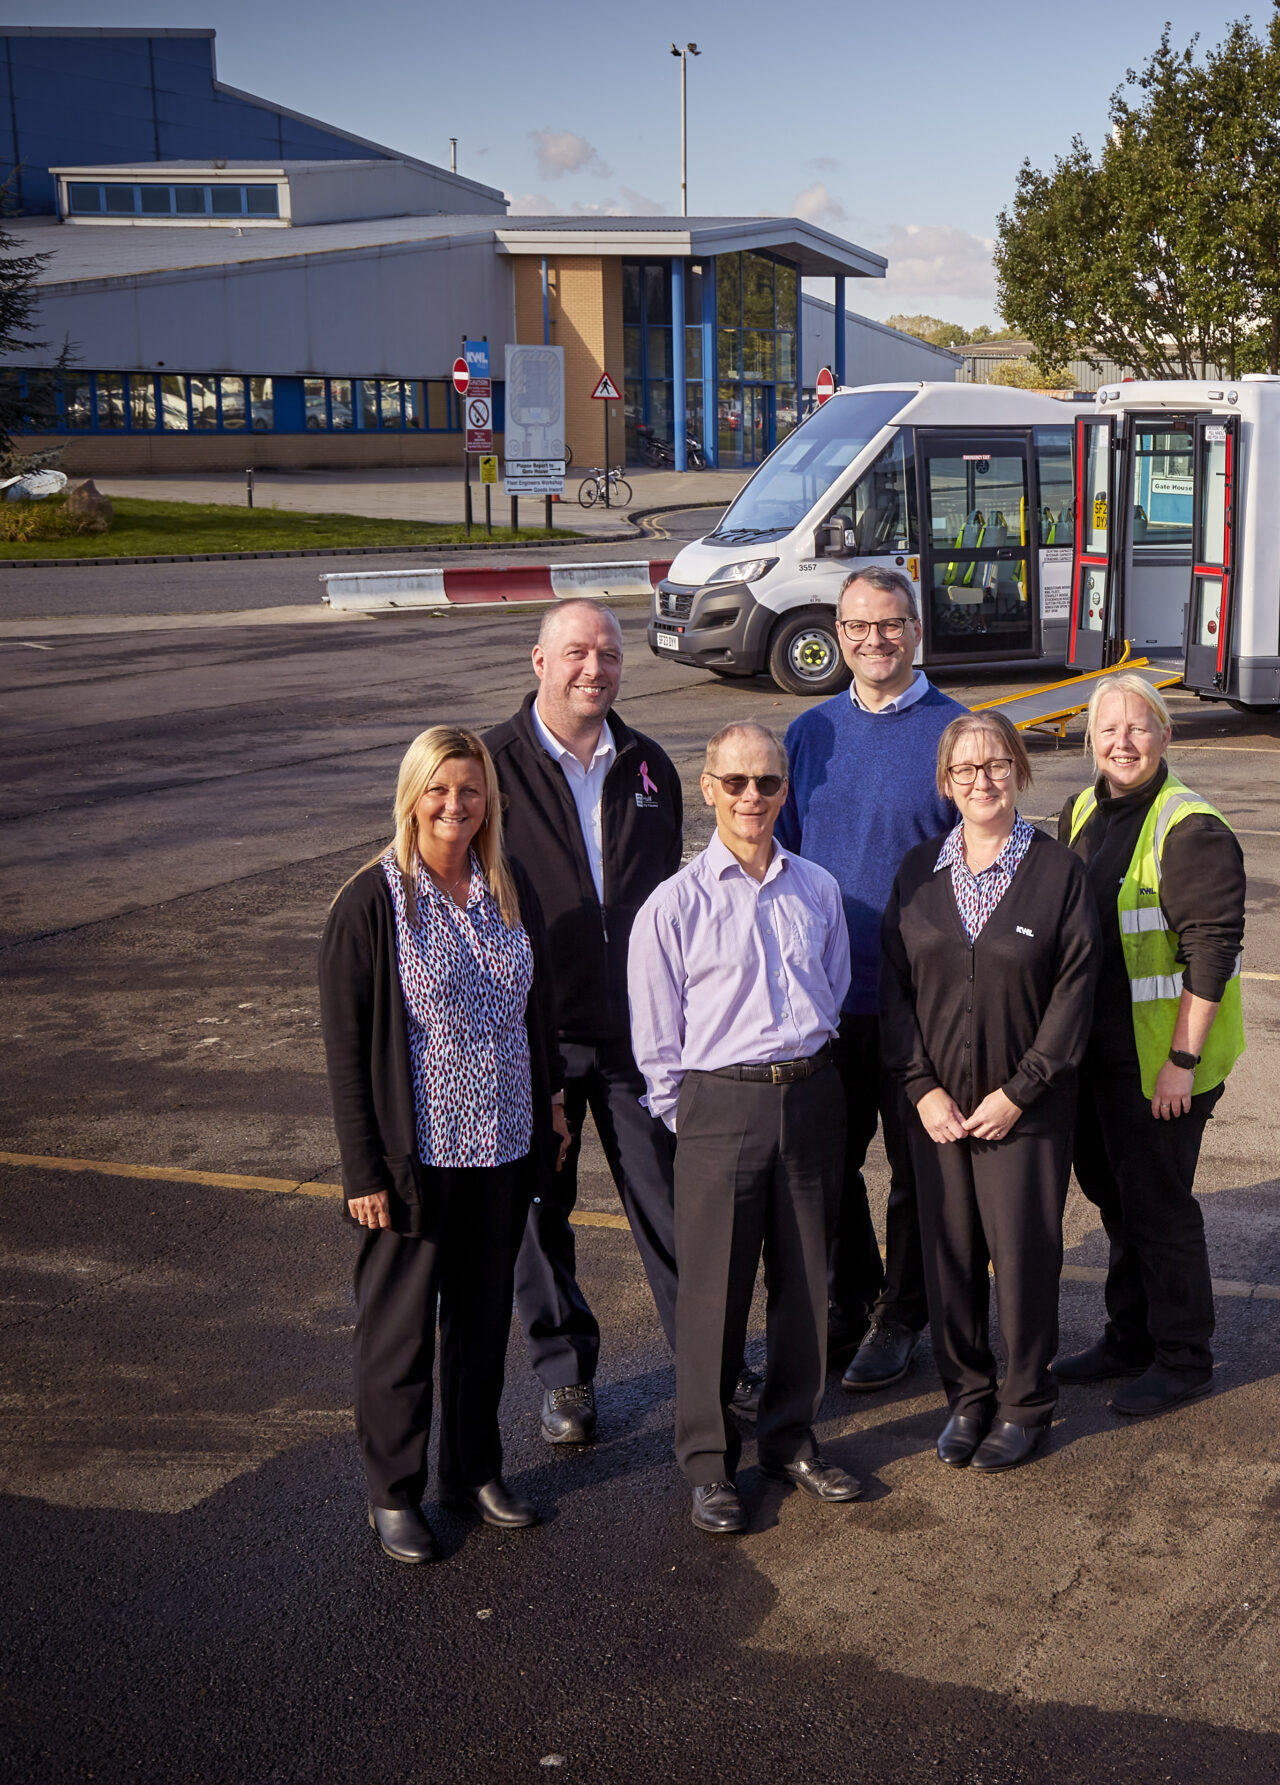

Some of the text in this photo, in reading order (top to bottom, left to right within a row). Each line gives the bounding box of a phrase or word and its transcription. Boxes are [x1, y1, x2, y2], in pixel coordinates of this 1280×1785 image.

[466, 352, 488, 363] KWL
[1095, 502, 1107, 514] SF2
[1016, 925, 1034, 938] KWL
